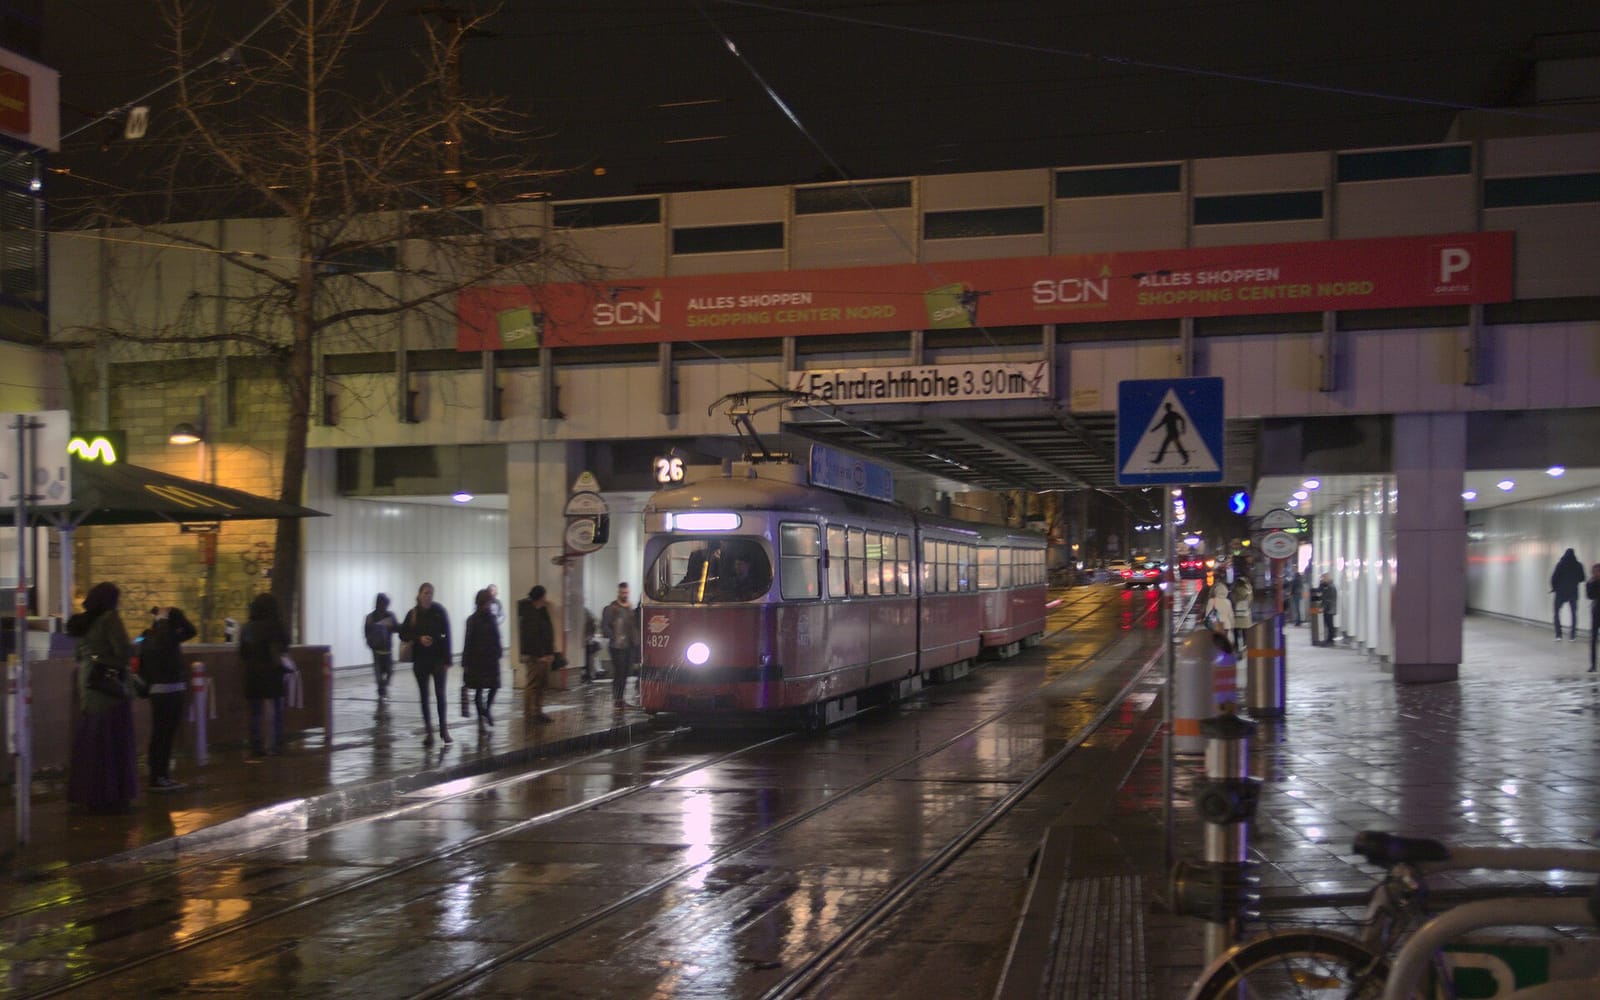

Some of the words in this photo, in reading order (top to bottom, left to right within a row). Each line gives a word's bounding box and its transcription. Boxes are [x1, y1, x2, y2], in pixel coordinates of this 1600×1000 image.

[1138, 271, 1192, 288] ALLES
[1196, 267, 1280, 285] SHOPPEN
[1441, 248, 1471, 283] P
[686, 296, 736, 310] ALLES
[738, 292, 813, 308] SHOPPEN
[1032, 278, 1109, 304] SCN
[1137, 288, 1233, 306] SHOPPING
[1238, 284, 1312, 301] CENTER
[1317, 280, 1374, 298] NORD
[593, 301, 661, 326] SCN
[687, 311, 770, 327] SHOPPING
[775, 308, 841, 323] CENTER
[846, 304, 897, 320] NORD
[809, 369, 959, 400] Fahrdrahthöhe
[656, 457, 684, 482] 26
